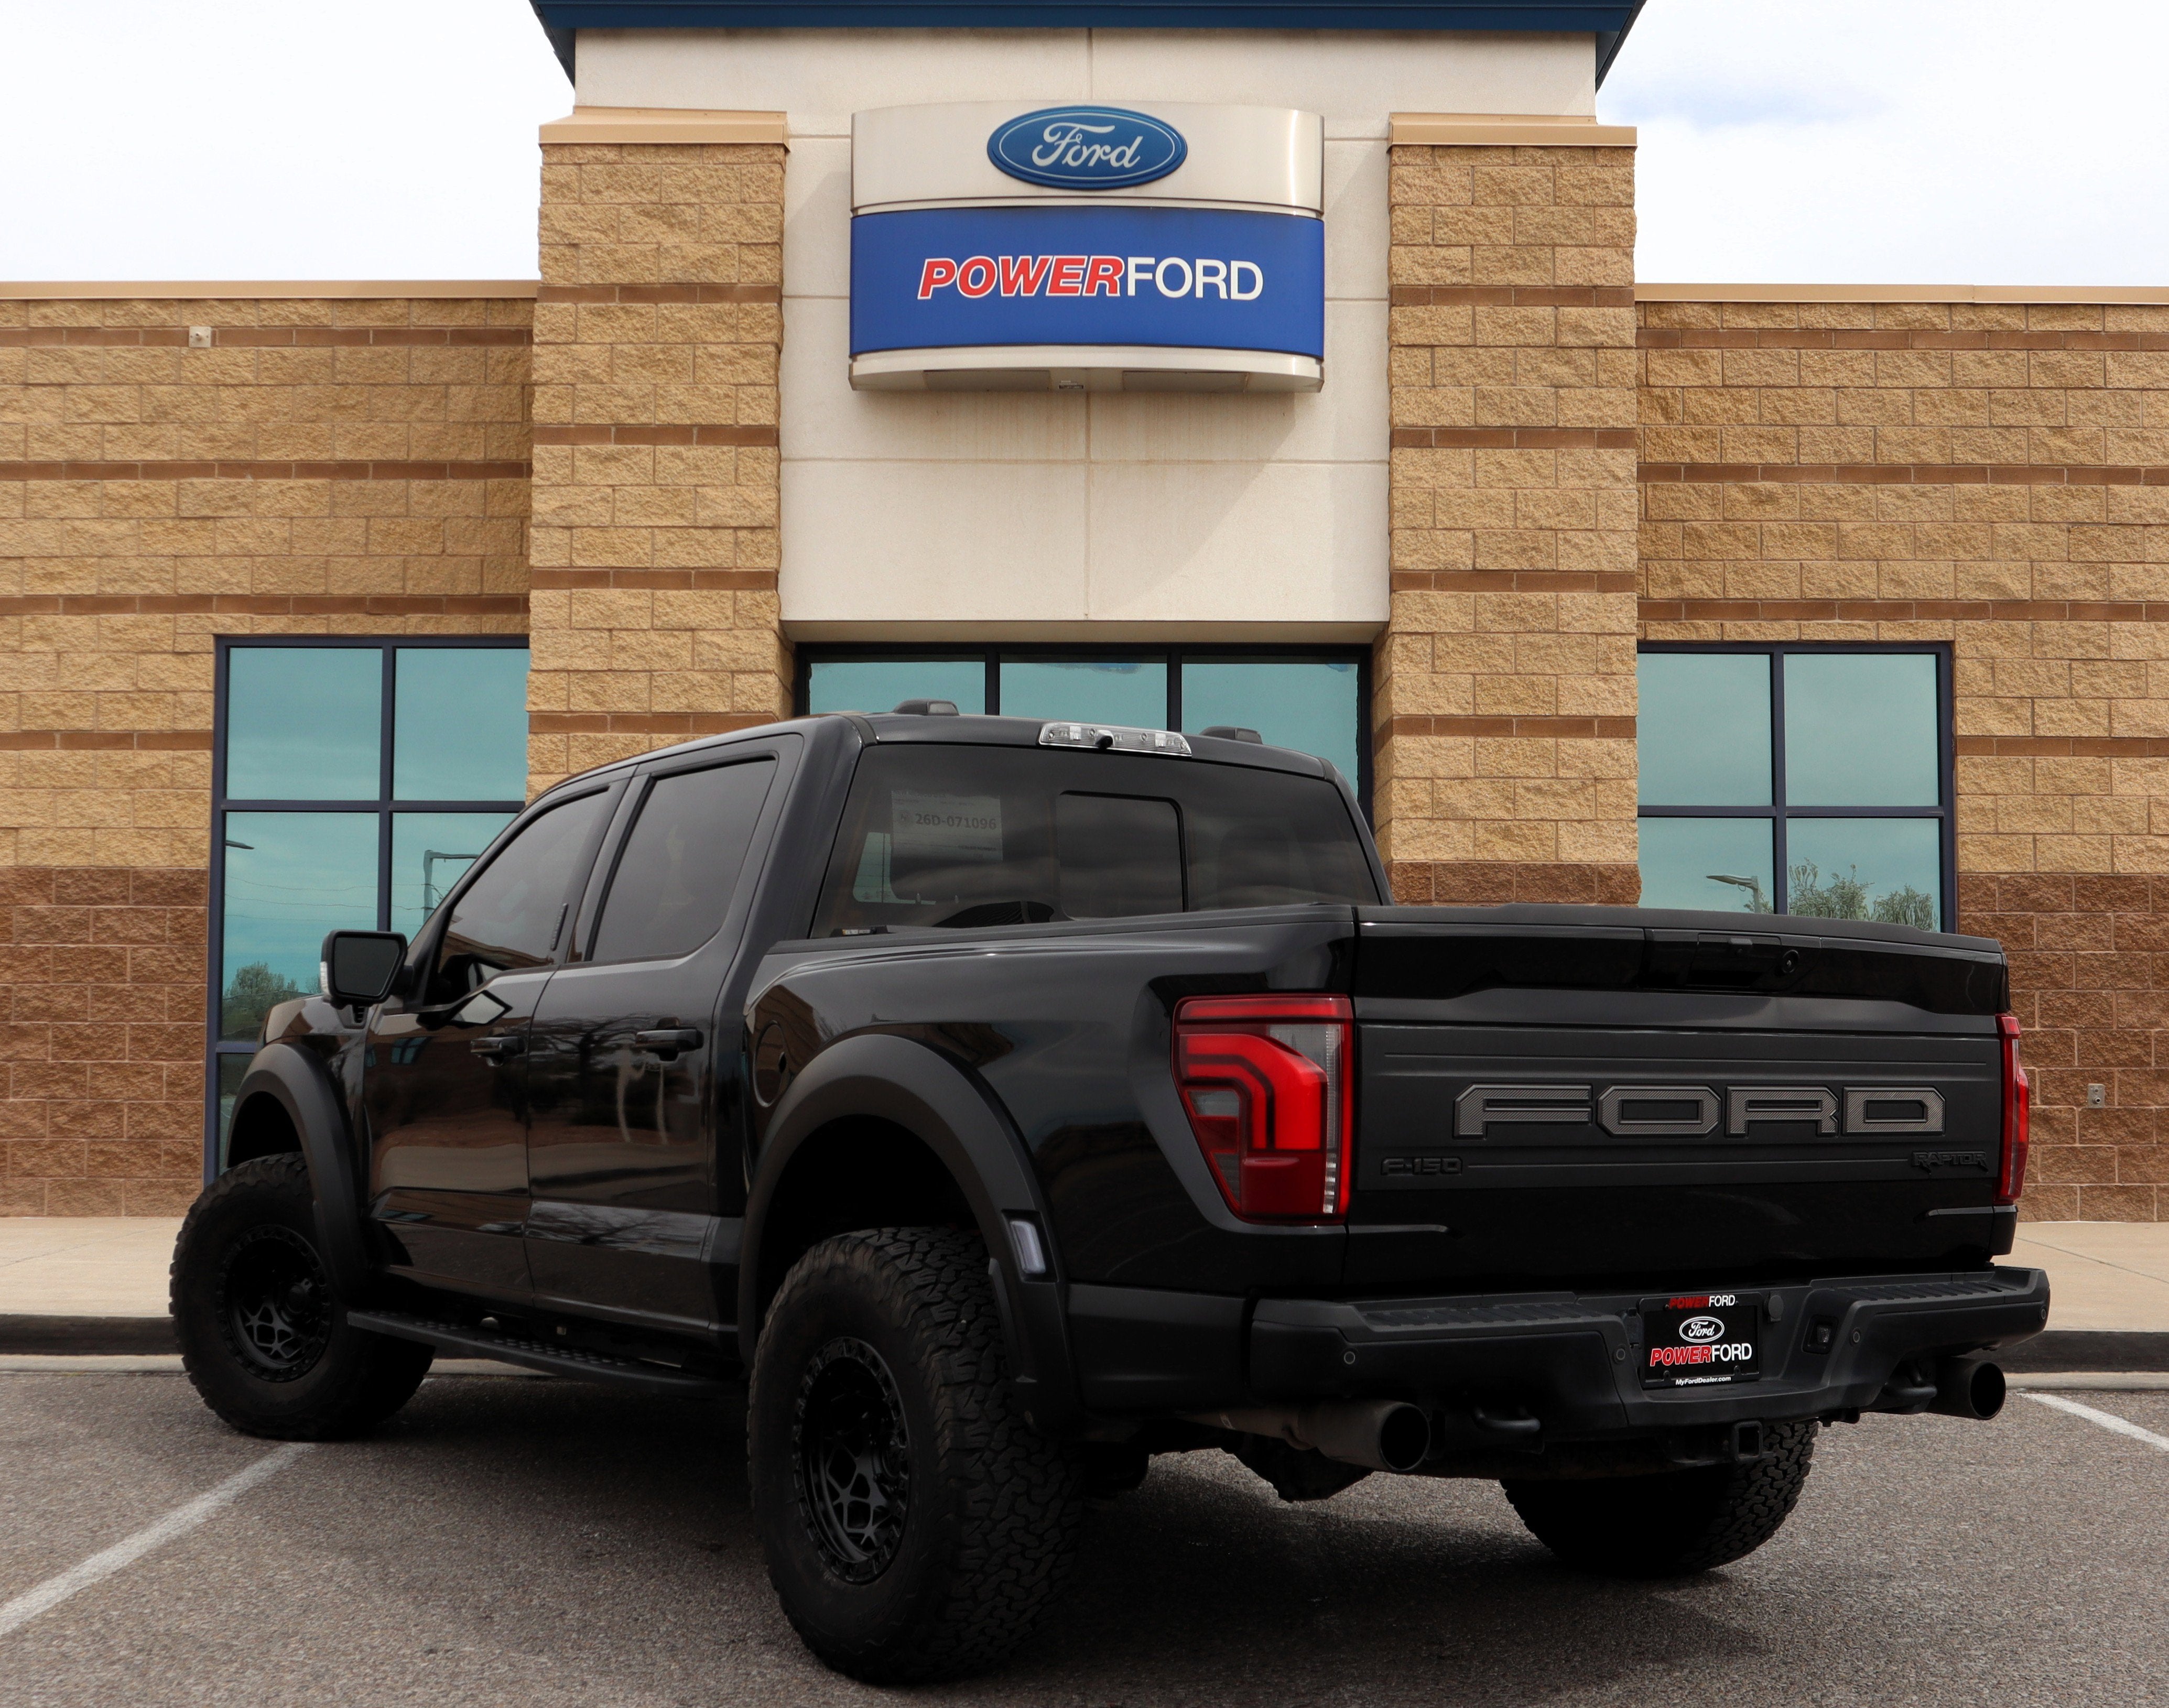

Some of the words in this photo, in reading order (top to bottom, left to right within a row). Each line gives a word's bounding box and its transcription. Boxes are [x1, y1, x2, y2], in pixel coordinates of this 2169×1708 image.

[1032, 122, 1144, 168] Ford
[915, 812, 997, 830] 26D-071096
[1453, 1084, 1947, 1139] FORD
[1381, 1157, 1463, 1176] F-150
[1912, 1150, 1989, 1174] RAPTOR
[1688, 1321, 1715, 1336] Ford
[1675, 1376, 1731, 1386] MyFordDealer.com
